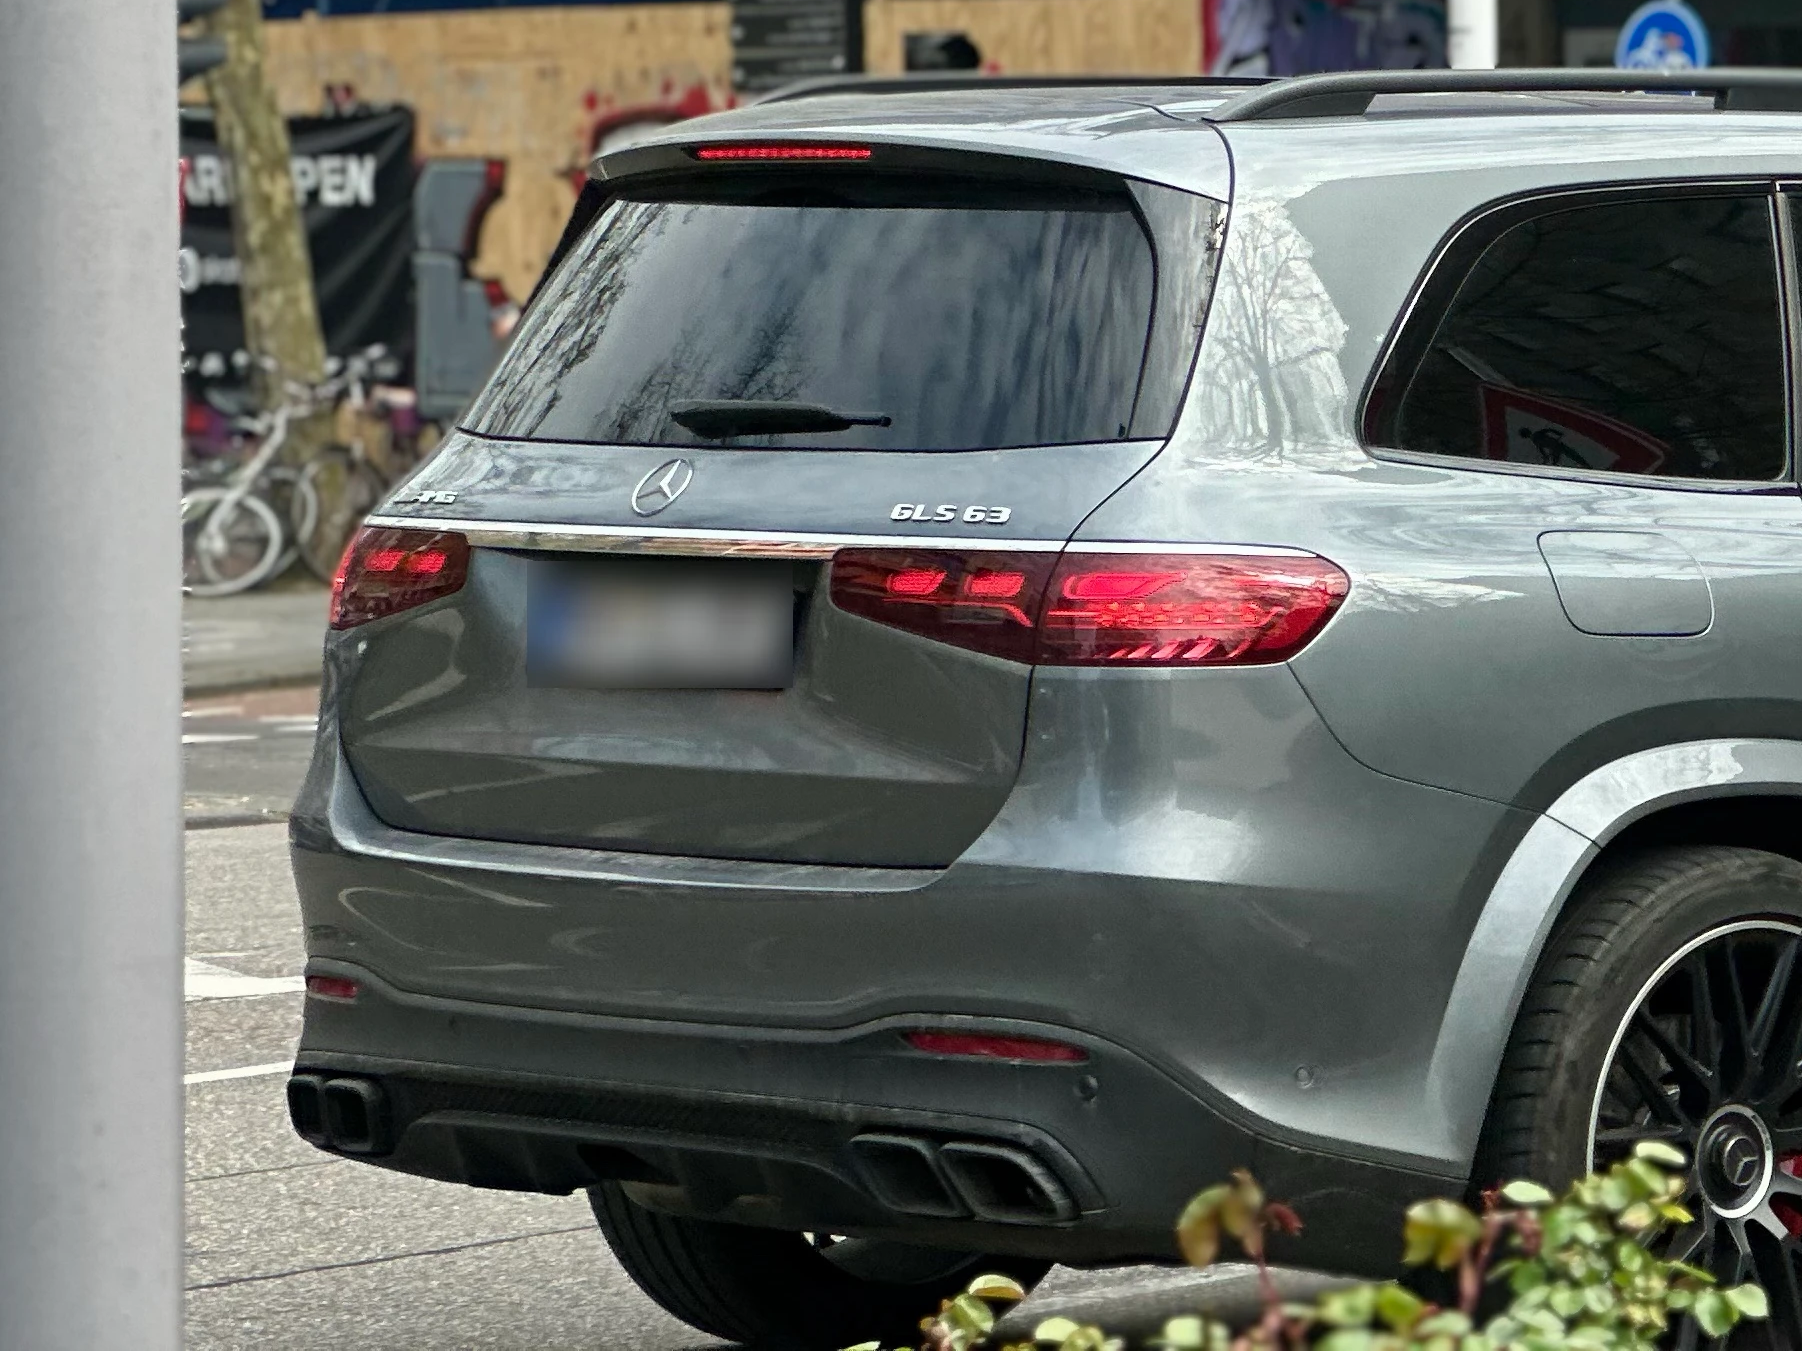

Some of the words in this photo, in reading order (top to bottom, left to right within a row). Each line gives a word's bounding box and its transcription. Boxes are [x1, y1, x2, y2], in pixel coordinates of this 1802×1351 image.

[292, 154, 377, 207] PEN
[889, 503, 957, 523] GLS
[962, 505, 1013, 525] 63
